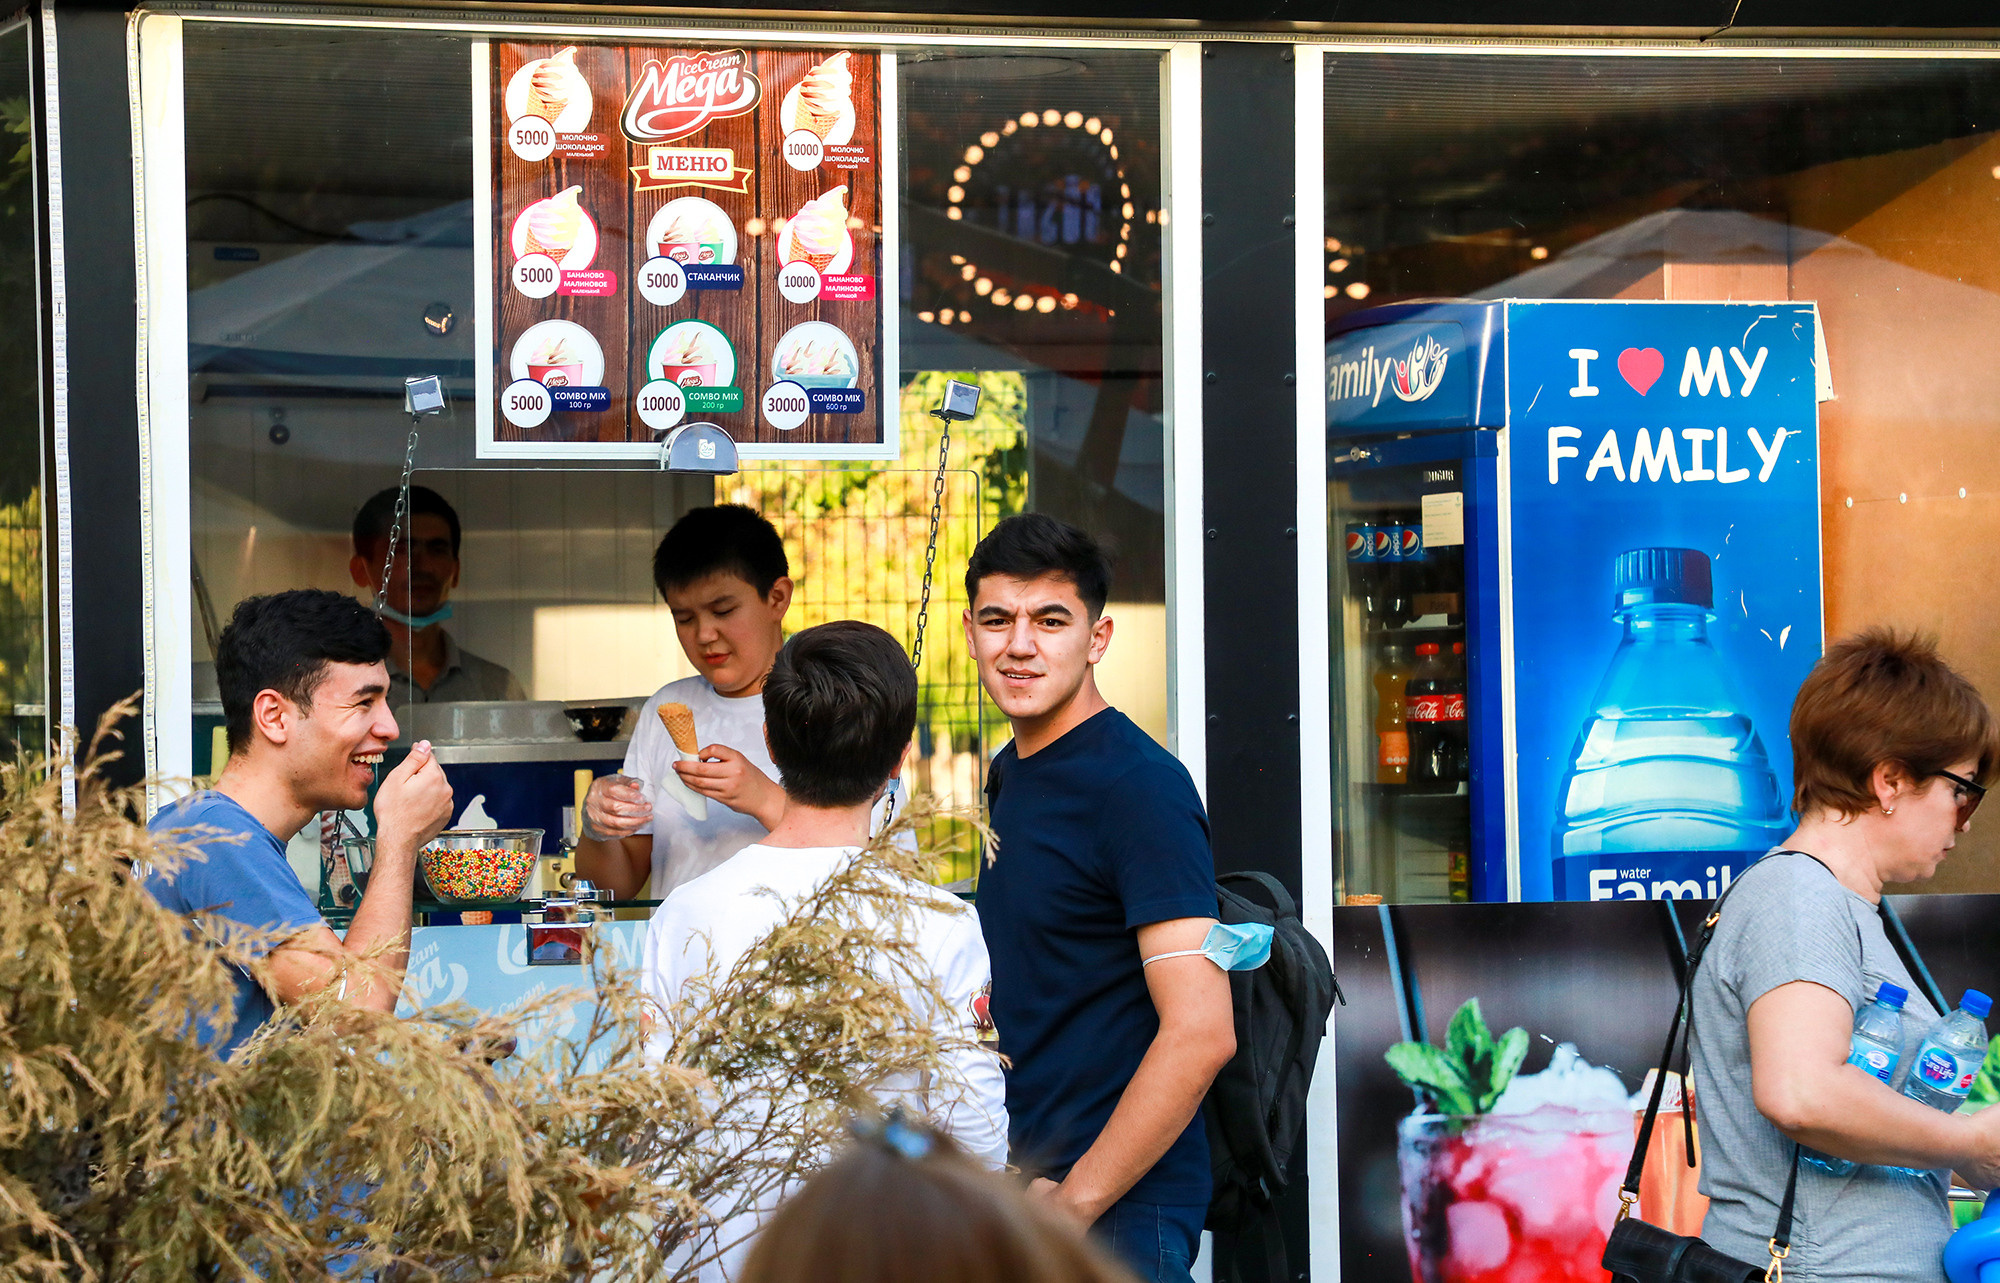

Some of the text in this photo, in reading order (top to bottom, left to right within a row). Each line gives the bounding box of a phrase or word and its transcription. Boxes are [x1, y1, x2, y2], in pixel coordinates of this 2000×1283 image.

[680, 54, 741, 76] IceCream
[516, 130, 549, 145] 5000
[555, 143, 605, 152] ШОКОЛАДНОЕ
[788, 143, 819, 156] 10000
[830, 146, 864, 154] МОЛОЧНО
[656, 155, 728, 172] МЕНЮ
[824, 155, 870, 164] ШОКОЛАДНОЕ
[520, 267, 553, 283] 5000
[566, 271, 605, 279] БАНАНОВО
[646, 273, 679, 288] 5000
[687, 272, 740, 282] СТАКАНЧИК
[784, 275, 815, 288] 10000
[1328, 346, 1392, 408] amily
[1568, 346, 1768, 398] I MY
[510, 395, 543, 411] 5000
[554, 392, 607, 400] COMBO MIX
[688, 392, 739, 400] COMBO MIX
[812, 394, 861, 402] COMBO MIX
[569, 401, 582, 409] 100
[642, 396, 680, 411] 10000
[702, 401, 716, 409] 200
[767, 397, 805, 412] 30000
[825, 403, 839, 411] 600
[1548, 426, 1787, 485] FAMILY
[1367, 532, 1375, 556] pepsi
[1392, 532, 1401, 556] pepsi
[1620, 867, 1651, 879] water
[1589, 865, 1732, 901] Famil
